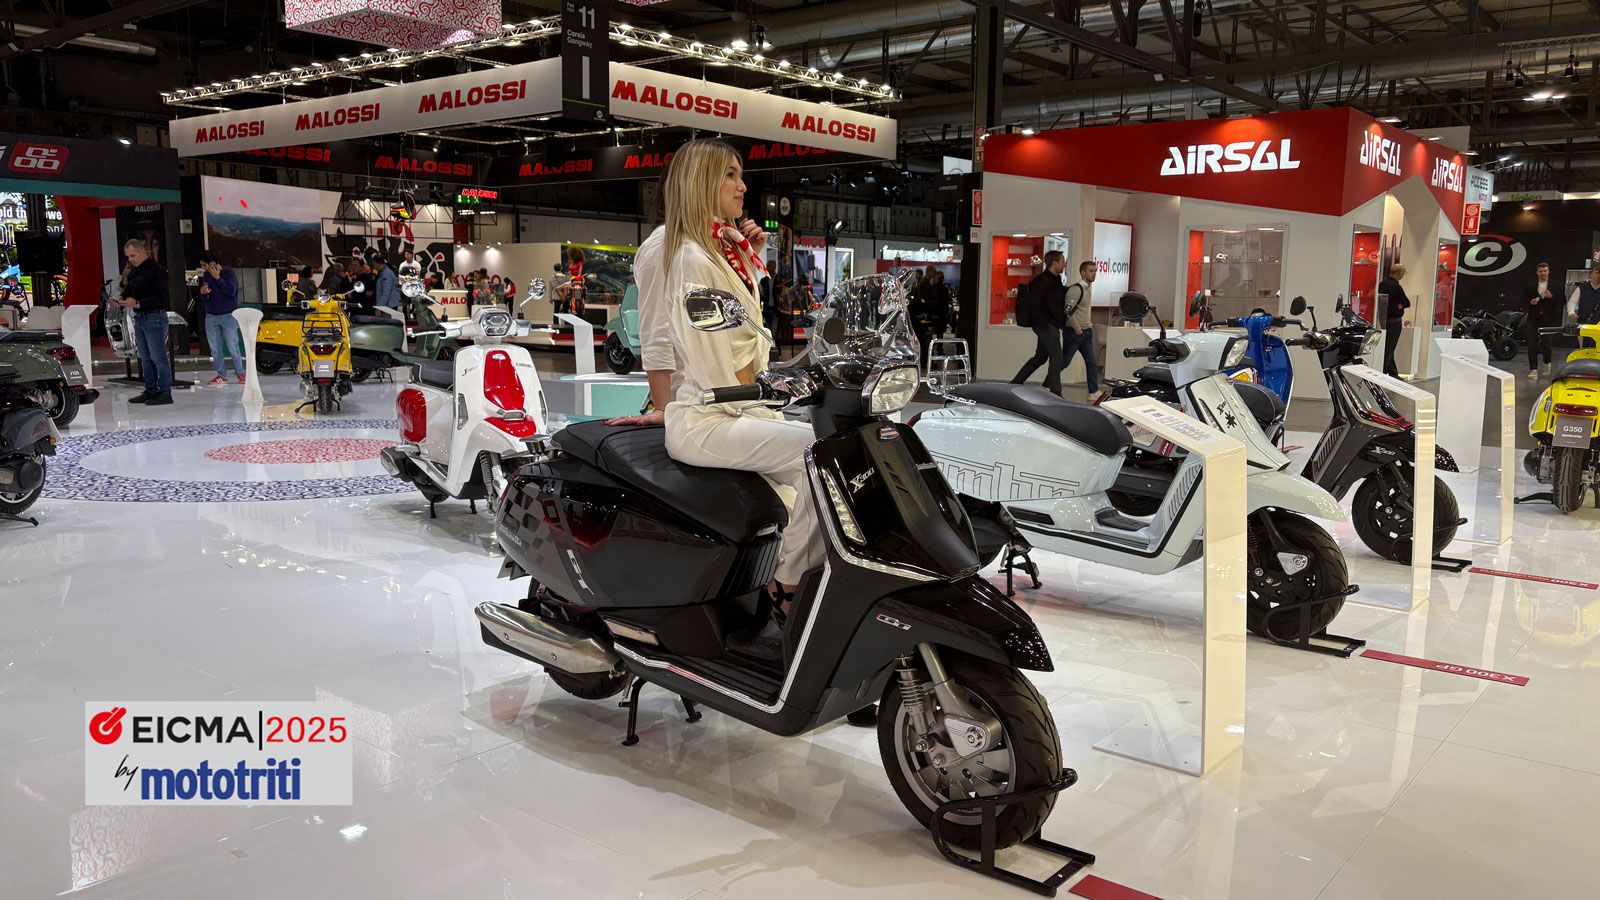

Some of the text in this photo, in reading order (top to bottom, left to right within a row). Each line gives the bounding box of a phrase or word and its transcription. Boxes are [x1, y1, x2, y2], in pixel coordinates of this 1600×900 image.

[579, 6, 595, 29] 11
[567, 29, 586, 39] Corsia
[567, 37, 593, 49] Gangway
[418, 79, 527, 113] MALOSSI
[611, 80, 739, 119] MALOSSI
[294, 103, 380, 131] MALOSSI
[195, 120, 265, 143] MALOSSI
[781, 112, 876, 143] MALOSSI
[624, 151, 672, 169] MALO
[747, 143, 836, 161] MALO
[374, 155, 474, 177] MALOSSI
[461, 187, 498, 199] MALOSSI
[16, 207, 27, 219] th
[797, 237, 826, 249] YMCO
[1094, 257, 1129, 274] irsal.com
[455, 274, 502, 288] KYO
[440, 296, 467, 305] MALO
[1563, 425, 1583, 433] G350
[850, 467, 875, 493] X300
[1436, 664, 1463, 672] GP
